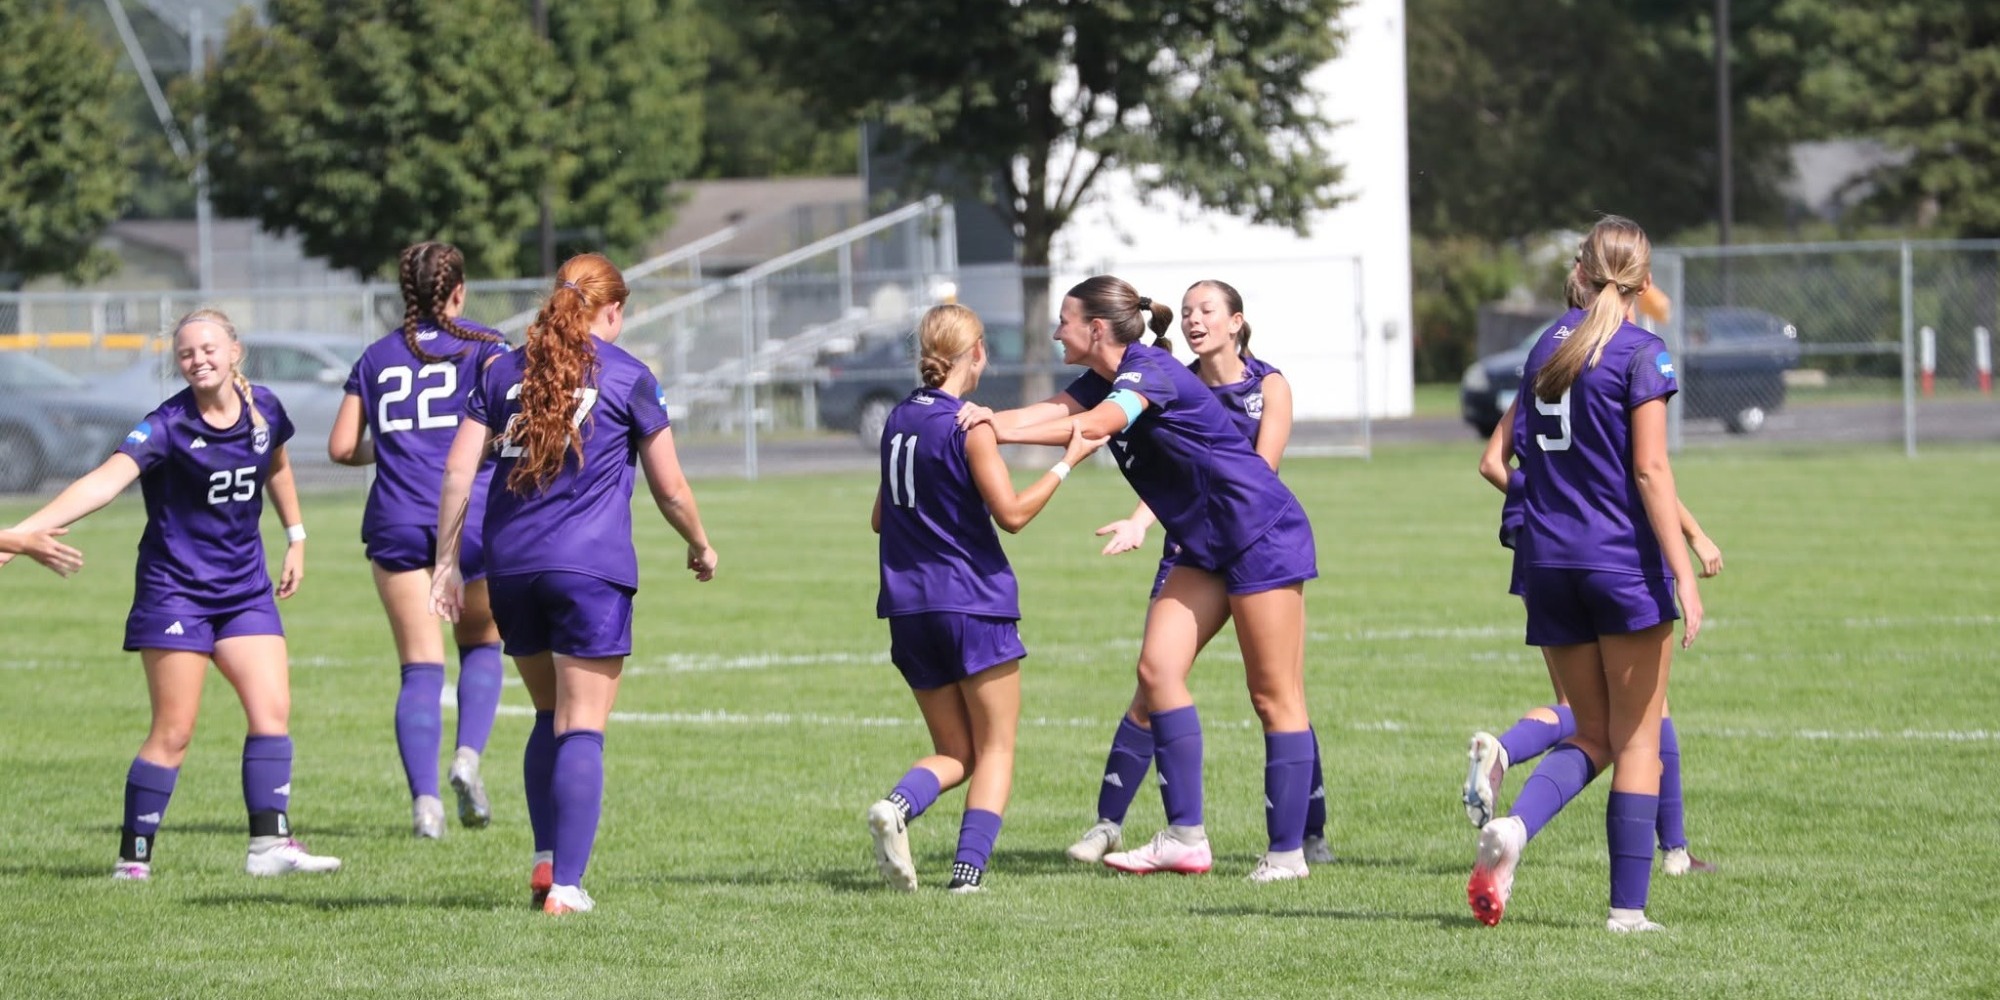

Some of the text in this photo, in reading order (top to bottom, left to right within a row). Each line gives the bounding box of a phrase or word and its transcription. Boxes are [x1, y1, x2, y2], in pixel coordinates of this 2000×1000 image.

[378, 361, 458, 433] 22
[1535, 386, 1572, 451] 9
[207, 466, 257, 505] 25
[890, 433, 917, 508] 11
